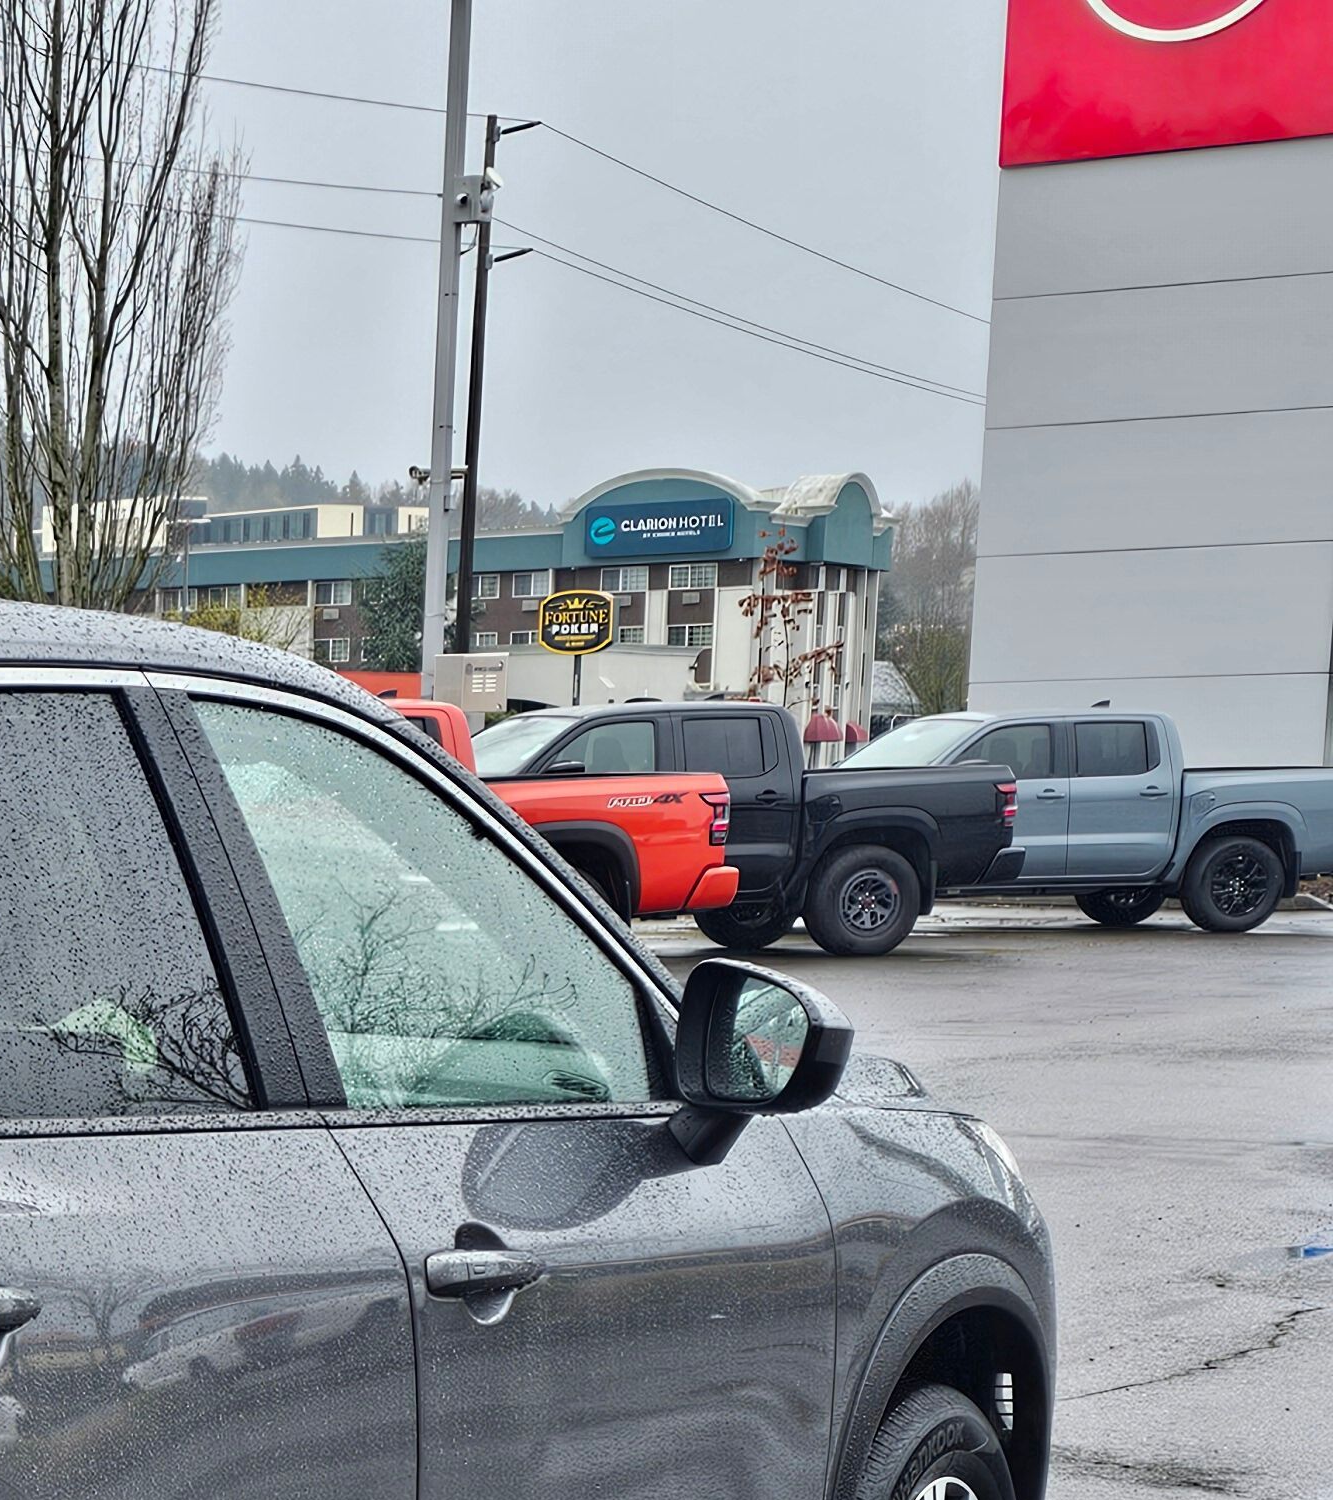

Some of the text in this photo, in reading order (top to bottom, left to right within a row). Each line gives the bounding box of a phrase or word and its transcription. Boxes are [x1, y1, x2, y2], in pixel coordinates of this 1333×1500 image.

[621, 514, 724, 532] CLARION HOTEL
[544, 609, 609, 625] FORTUNE
[551, 623, 598, 635] POKER
